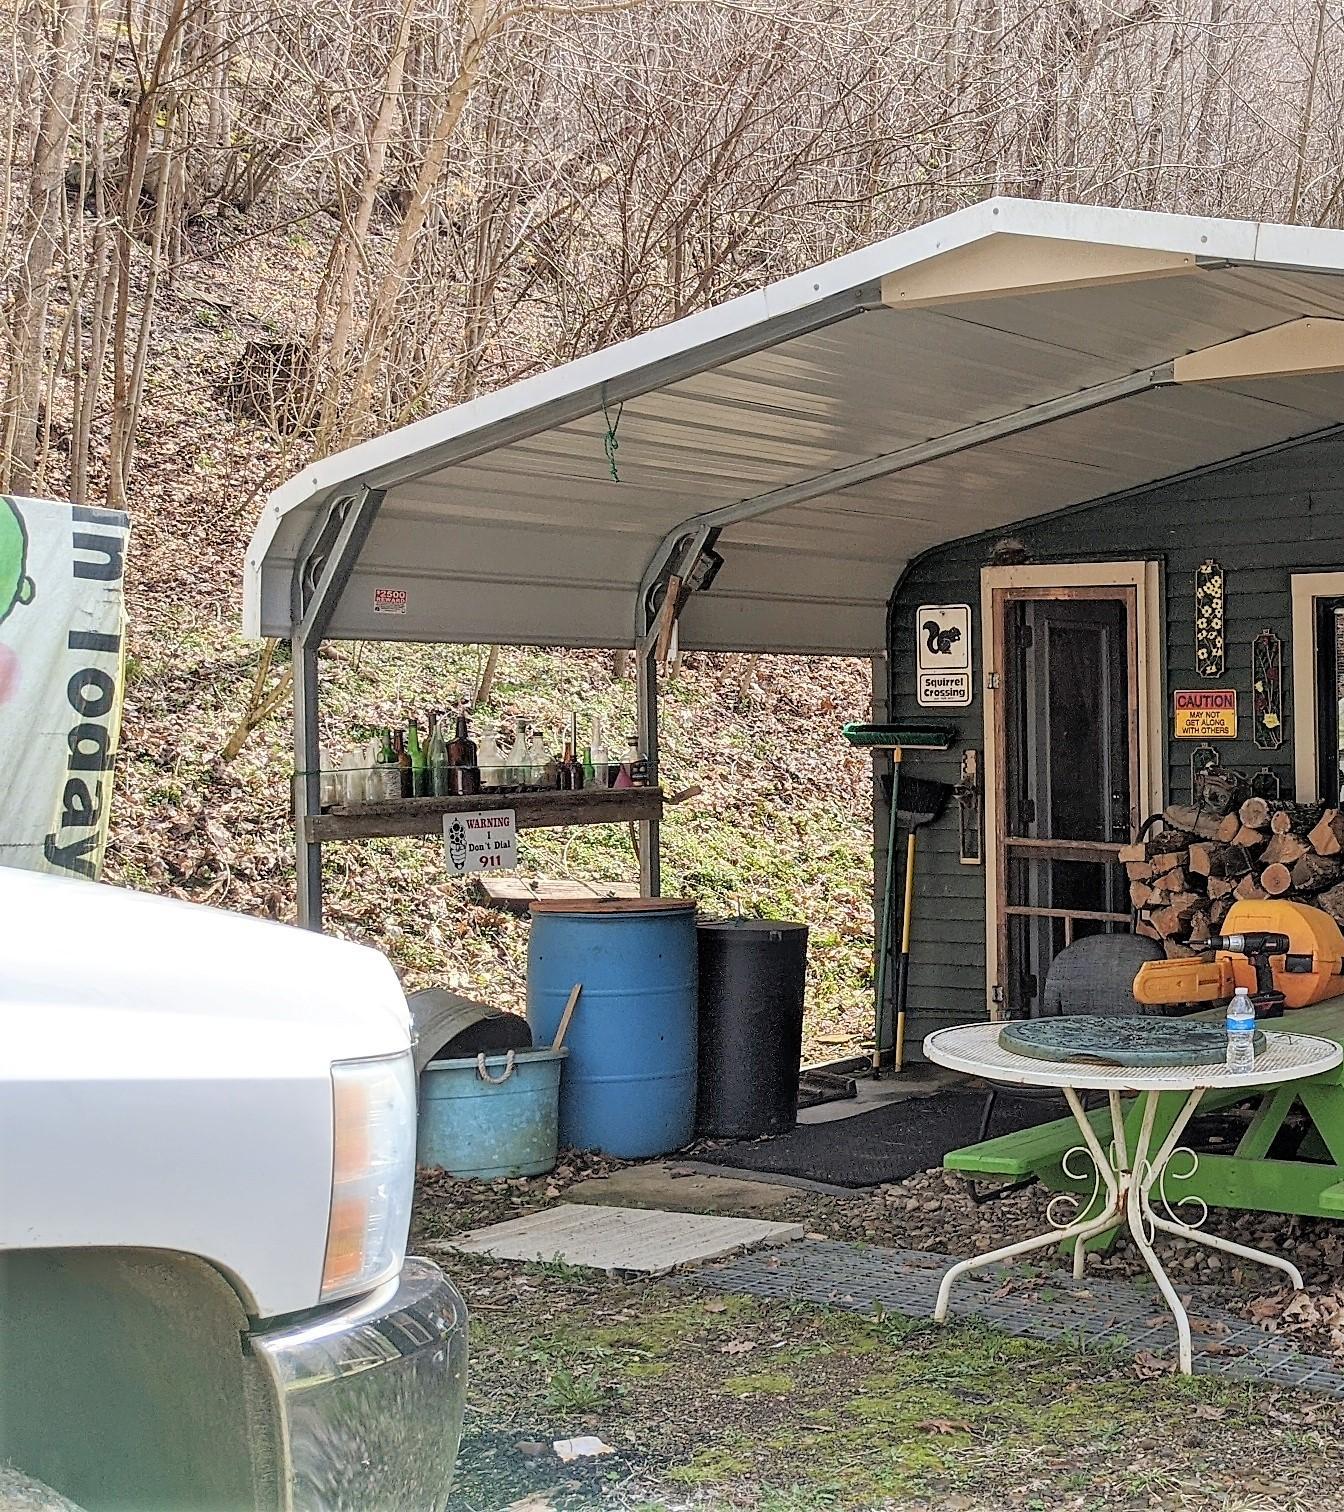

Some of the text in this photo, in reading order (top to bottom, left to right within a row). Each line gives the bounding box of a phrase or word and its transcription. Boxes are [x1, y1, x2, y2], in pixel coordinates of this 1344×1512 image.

[925, 677, 964, 688] Squirrel
[924, 687, 966, 698] Crossing
[1177, 694, 1233, 708] CAUTION
[1189, 711, 1221, 719] MAY NOT
[466, 816, 510, 829] WARNING
[468, 840, 511, 852] Don't Dial
[480, 855, 501, 868] 911
